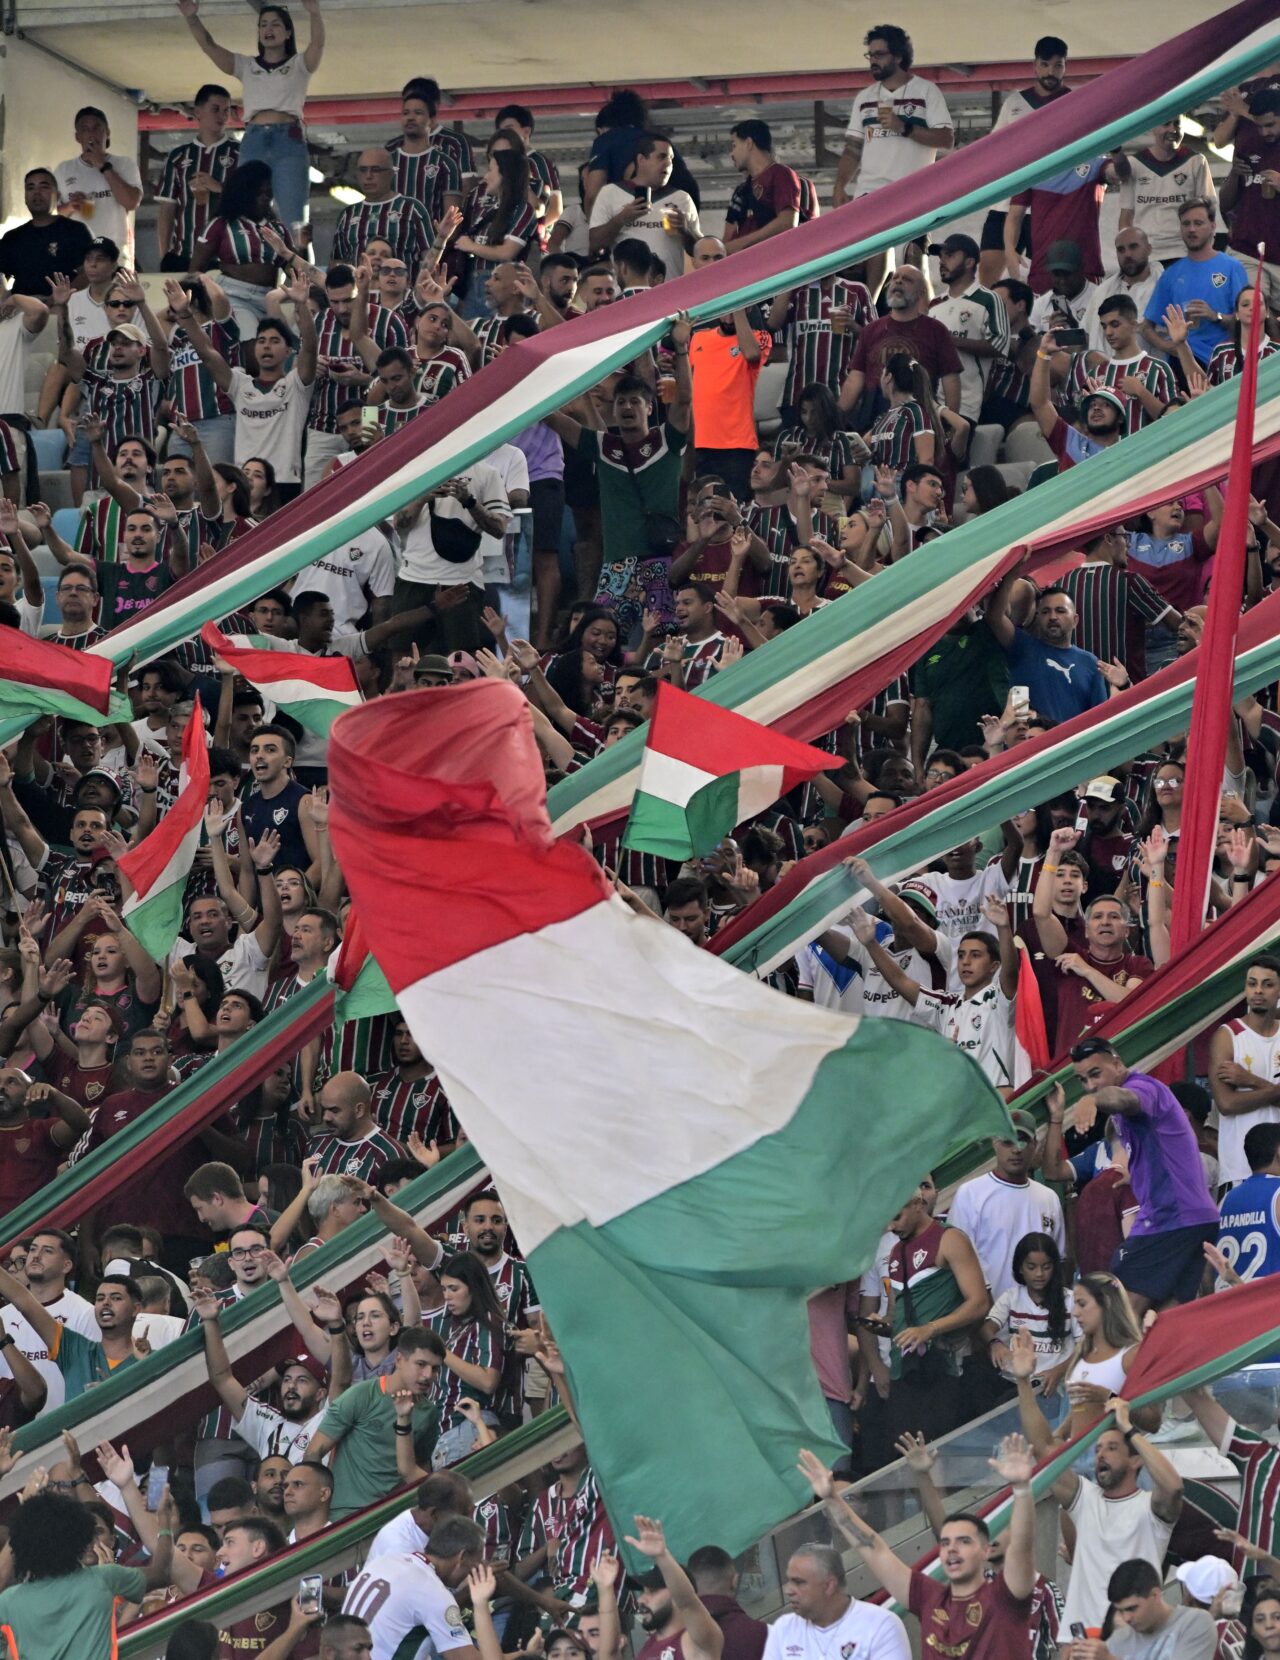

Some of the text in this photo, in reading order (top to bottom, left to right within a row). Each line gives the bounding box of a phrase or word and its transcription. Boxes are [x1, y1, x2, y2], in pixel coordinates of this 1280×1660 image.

[1137, 193, 1187, 204] SUPERBET
[312, 561, 354, 578] UPERBET
[65, 890, 90, 904] BETA
[1219, 1210, 1266, 1230] LA PANDILLA
[1214, 1231, 1268, 1292] 22
